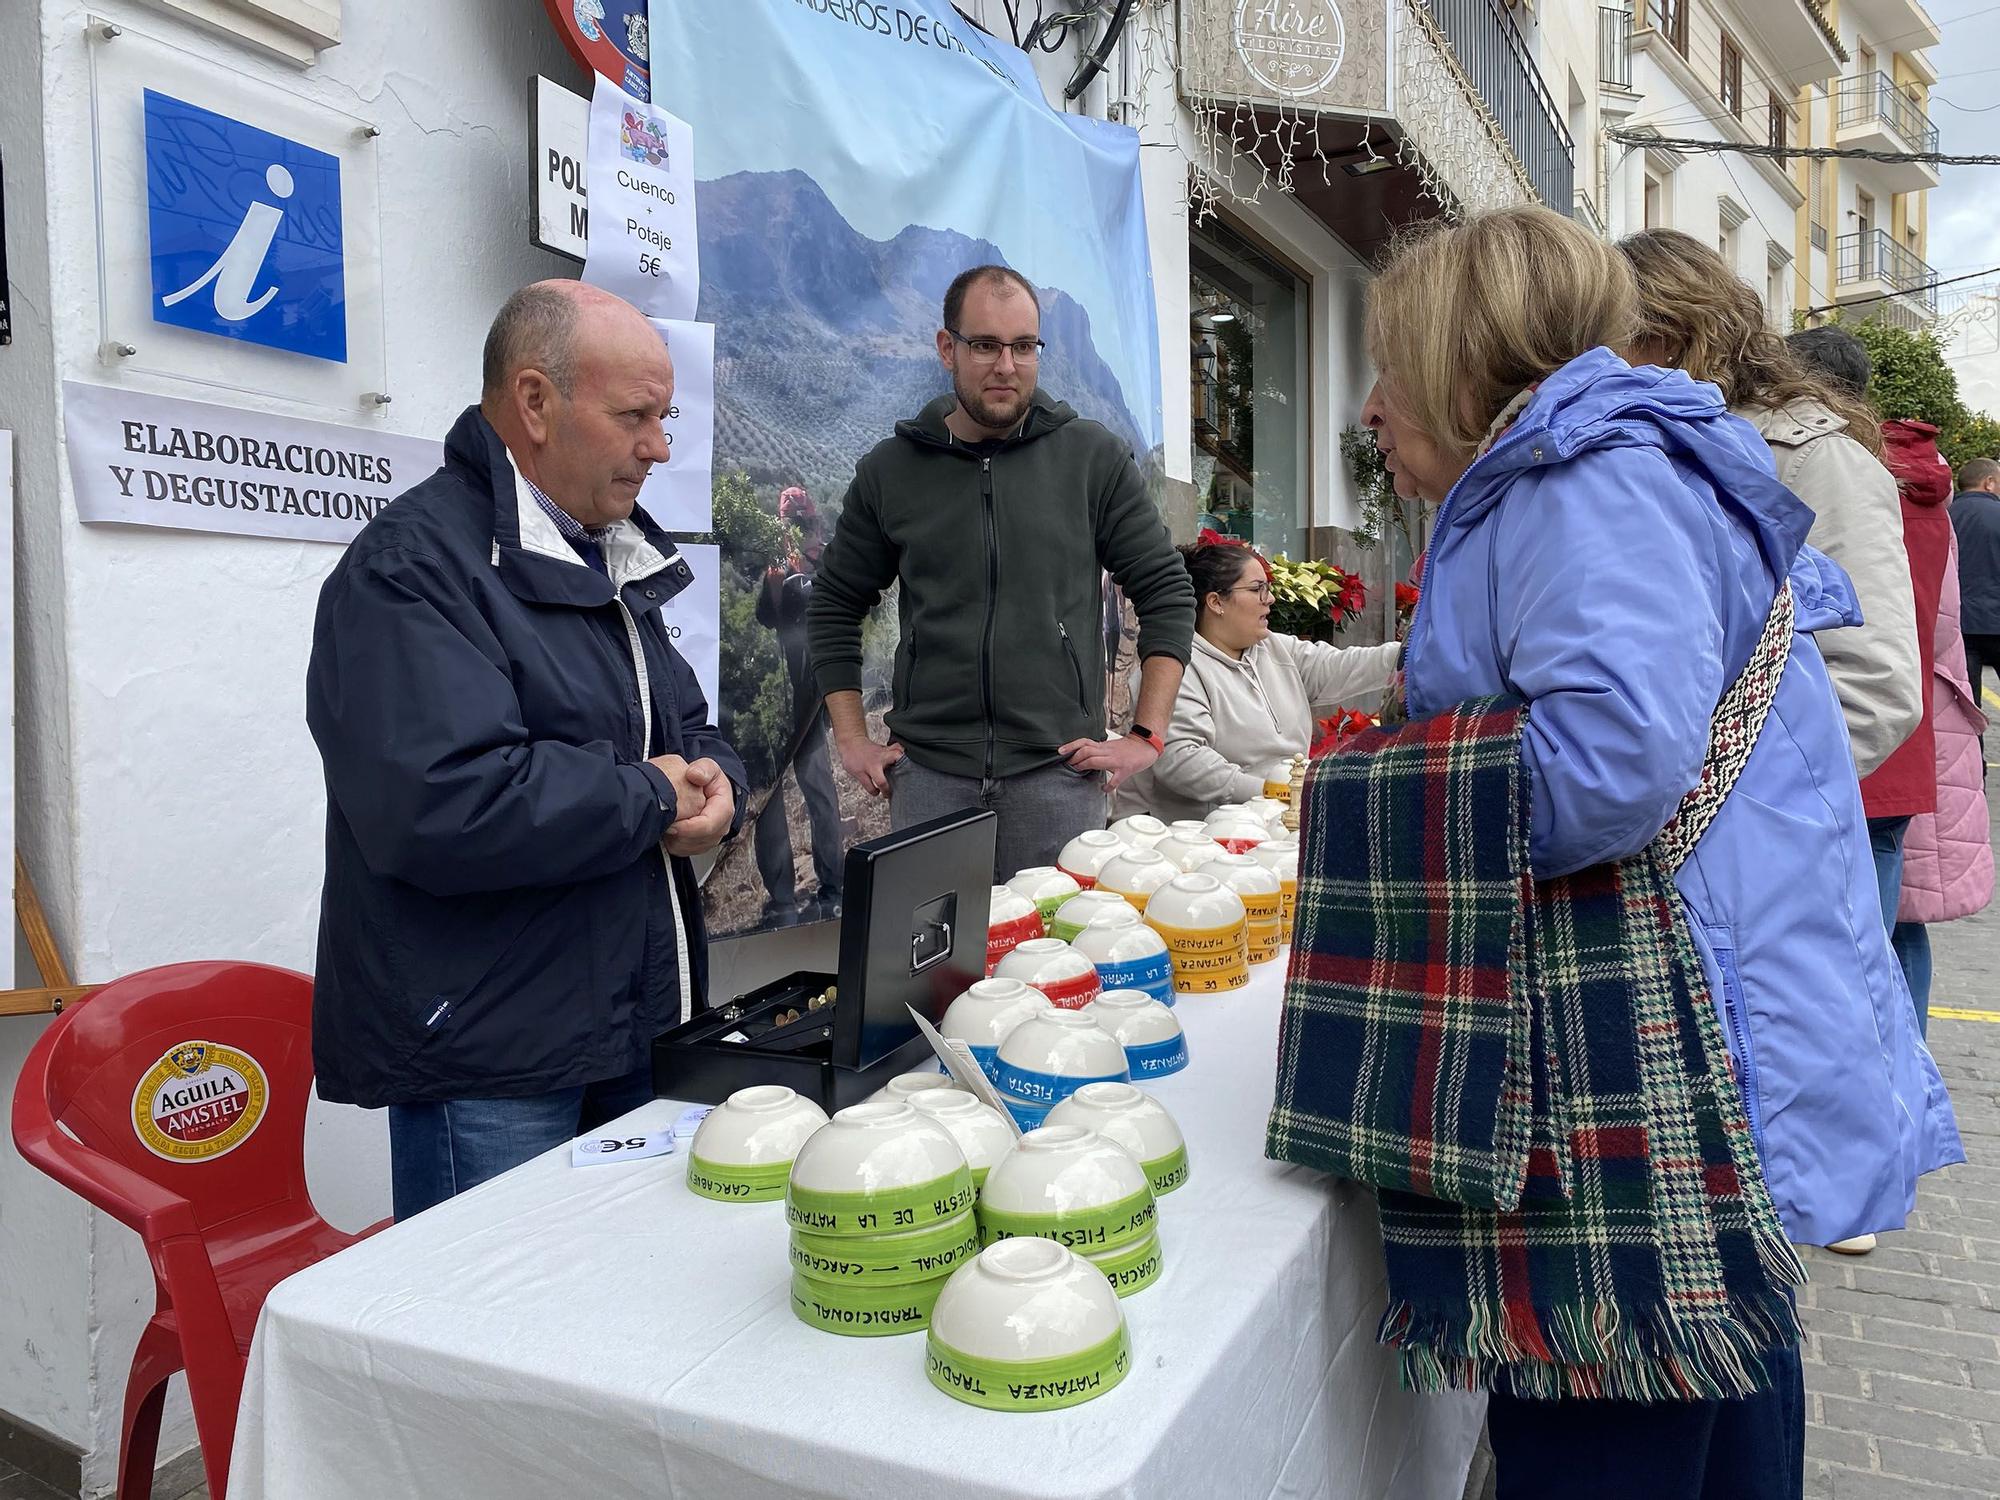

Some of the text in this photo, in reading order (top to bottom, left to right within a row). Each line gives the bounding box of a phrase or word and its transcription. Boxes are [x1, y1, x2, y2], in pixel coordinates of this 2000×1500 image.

[896, 9, 929, 45] DE
[1255, 0, 1327, 37] Aire
[617, 170, 675, 205] Cuenco
[626, 218, 672, 251] Potaje
[638, 252, 662, 277] 5€
[121, 420, 392, 484] ELABORACIONES
[109, 465, 134, 497] Y
[1146, 969, 1158, 980] LA
[1178, 981, 1191, 990] LA
[1205, 980, 1217, 990] DE
[1140, 1051, 1186, 1071] MATANZA
[161, 1076, 236, 1113] AGUILA
[1008, 1076, 1054, 1100] FIESTA
[168, 1096, 243, 1134] AMSTEL
[1153, 1164, 1189, 1191] FIESTA
[933, 1186, 972, 1216] FIESTA
[858, 1214, 877, 1229] LA
[893, 1208, 915, 1225] DE
[812, 1302, 923, 1325] TRADICIONAL
[1114, 1350, 1129, 1373] LA
[1007, 1371, 1101, 1400] MATANZA
